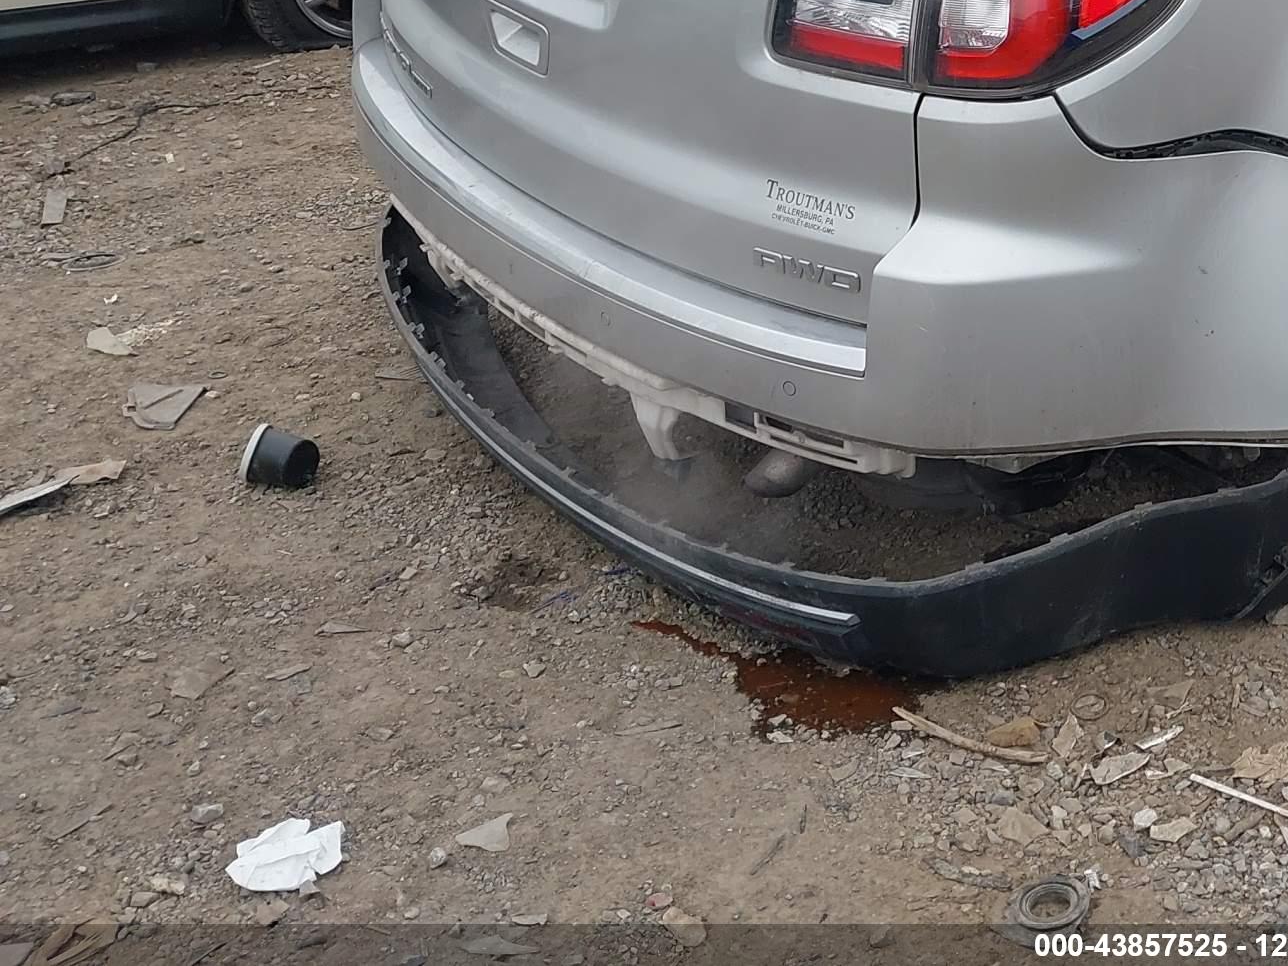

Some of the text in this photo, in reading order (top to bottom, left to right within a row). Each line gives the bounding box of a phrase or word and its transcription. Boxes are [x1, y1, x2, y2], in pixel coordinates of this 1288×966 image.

[776, 204, 834, 226] MILLERSBURG, PA
[753, 246, 861, 293] AWD
